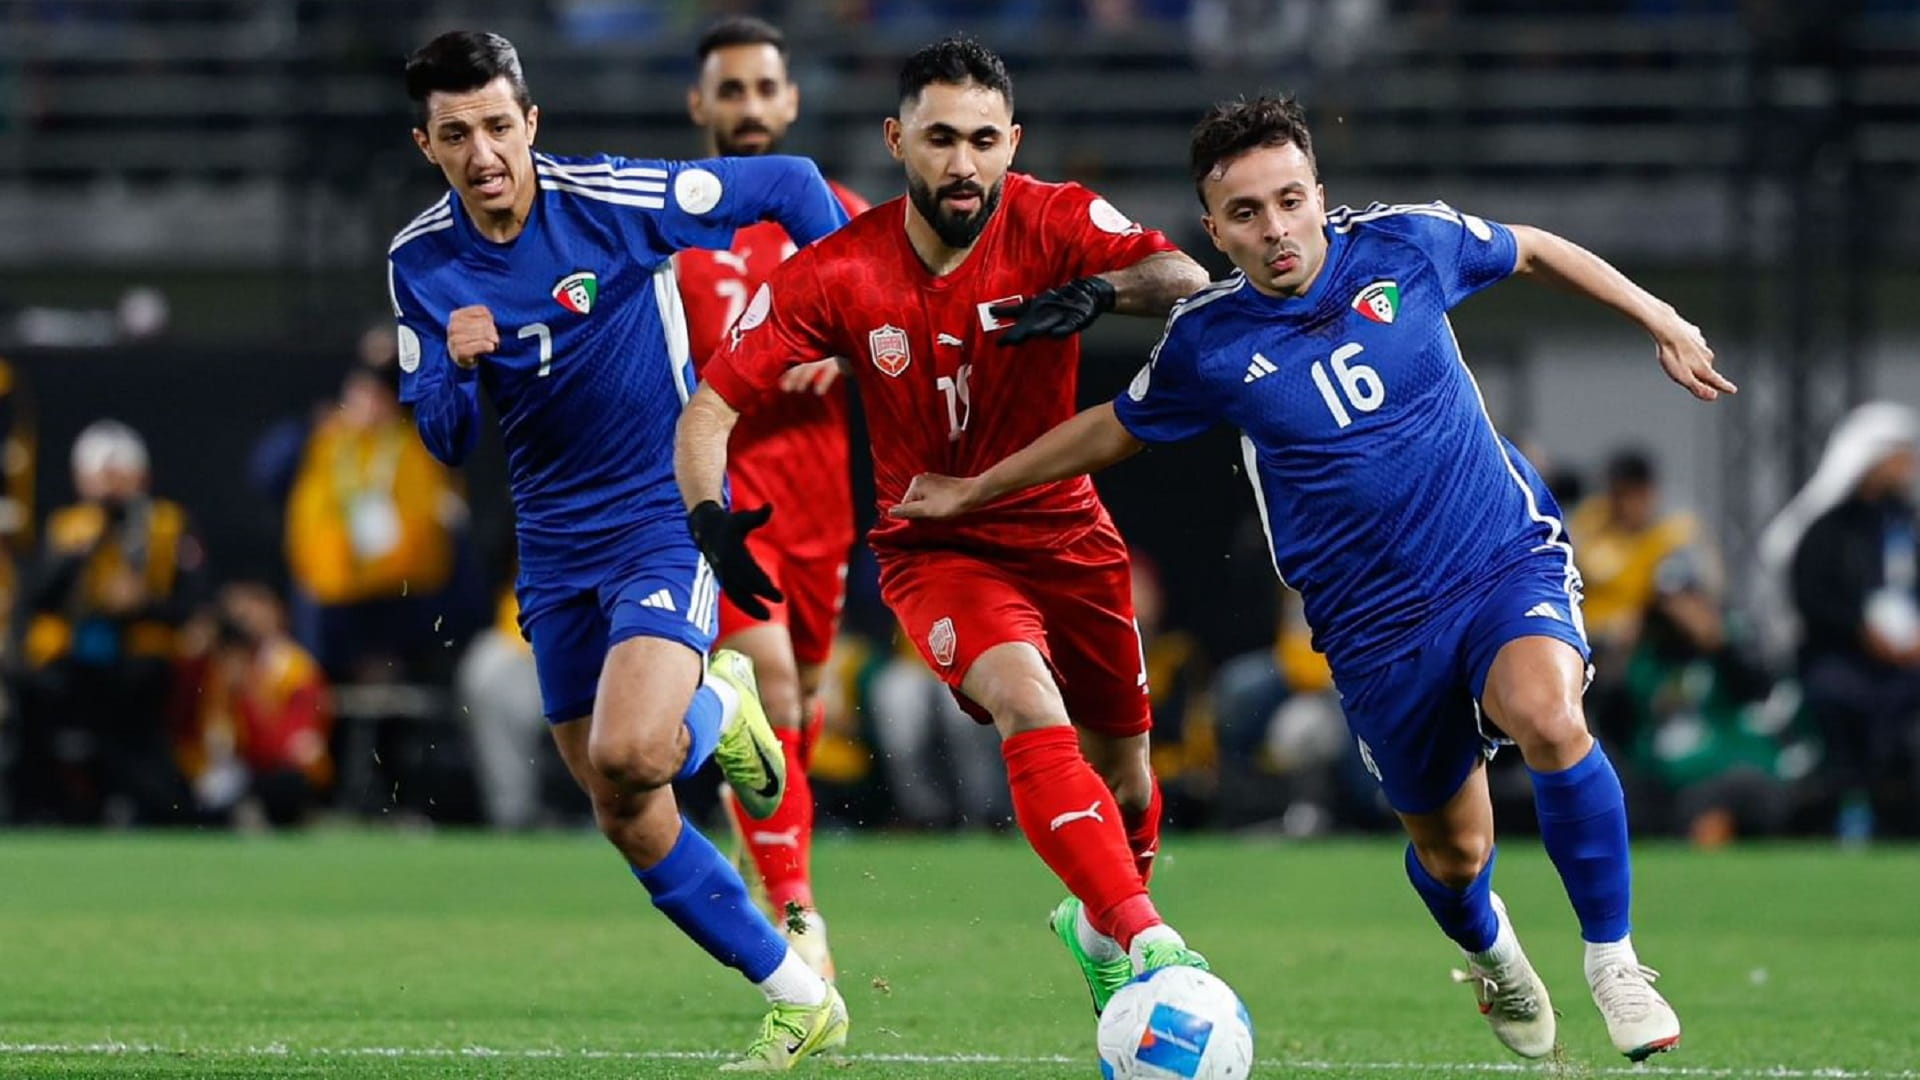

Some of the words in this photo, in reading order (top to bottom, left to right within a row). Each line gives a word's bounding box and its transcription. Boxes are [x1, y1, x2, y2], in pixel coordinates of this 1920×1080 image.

[714, 277, 748, 339] 7
[517, 322, 553, 378] 7
[1311, 342, 1386, 429] 16
